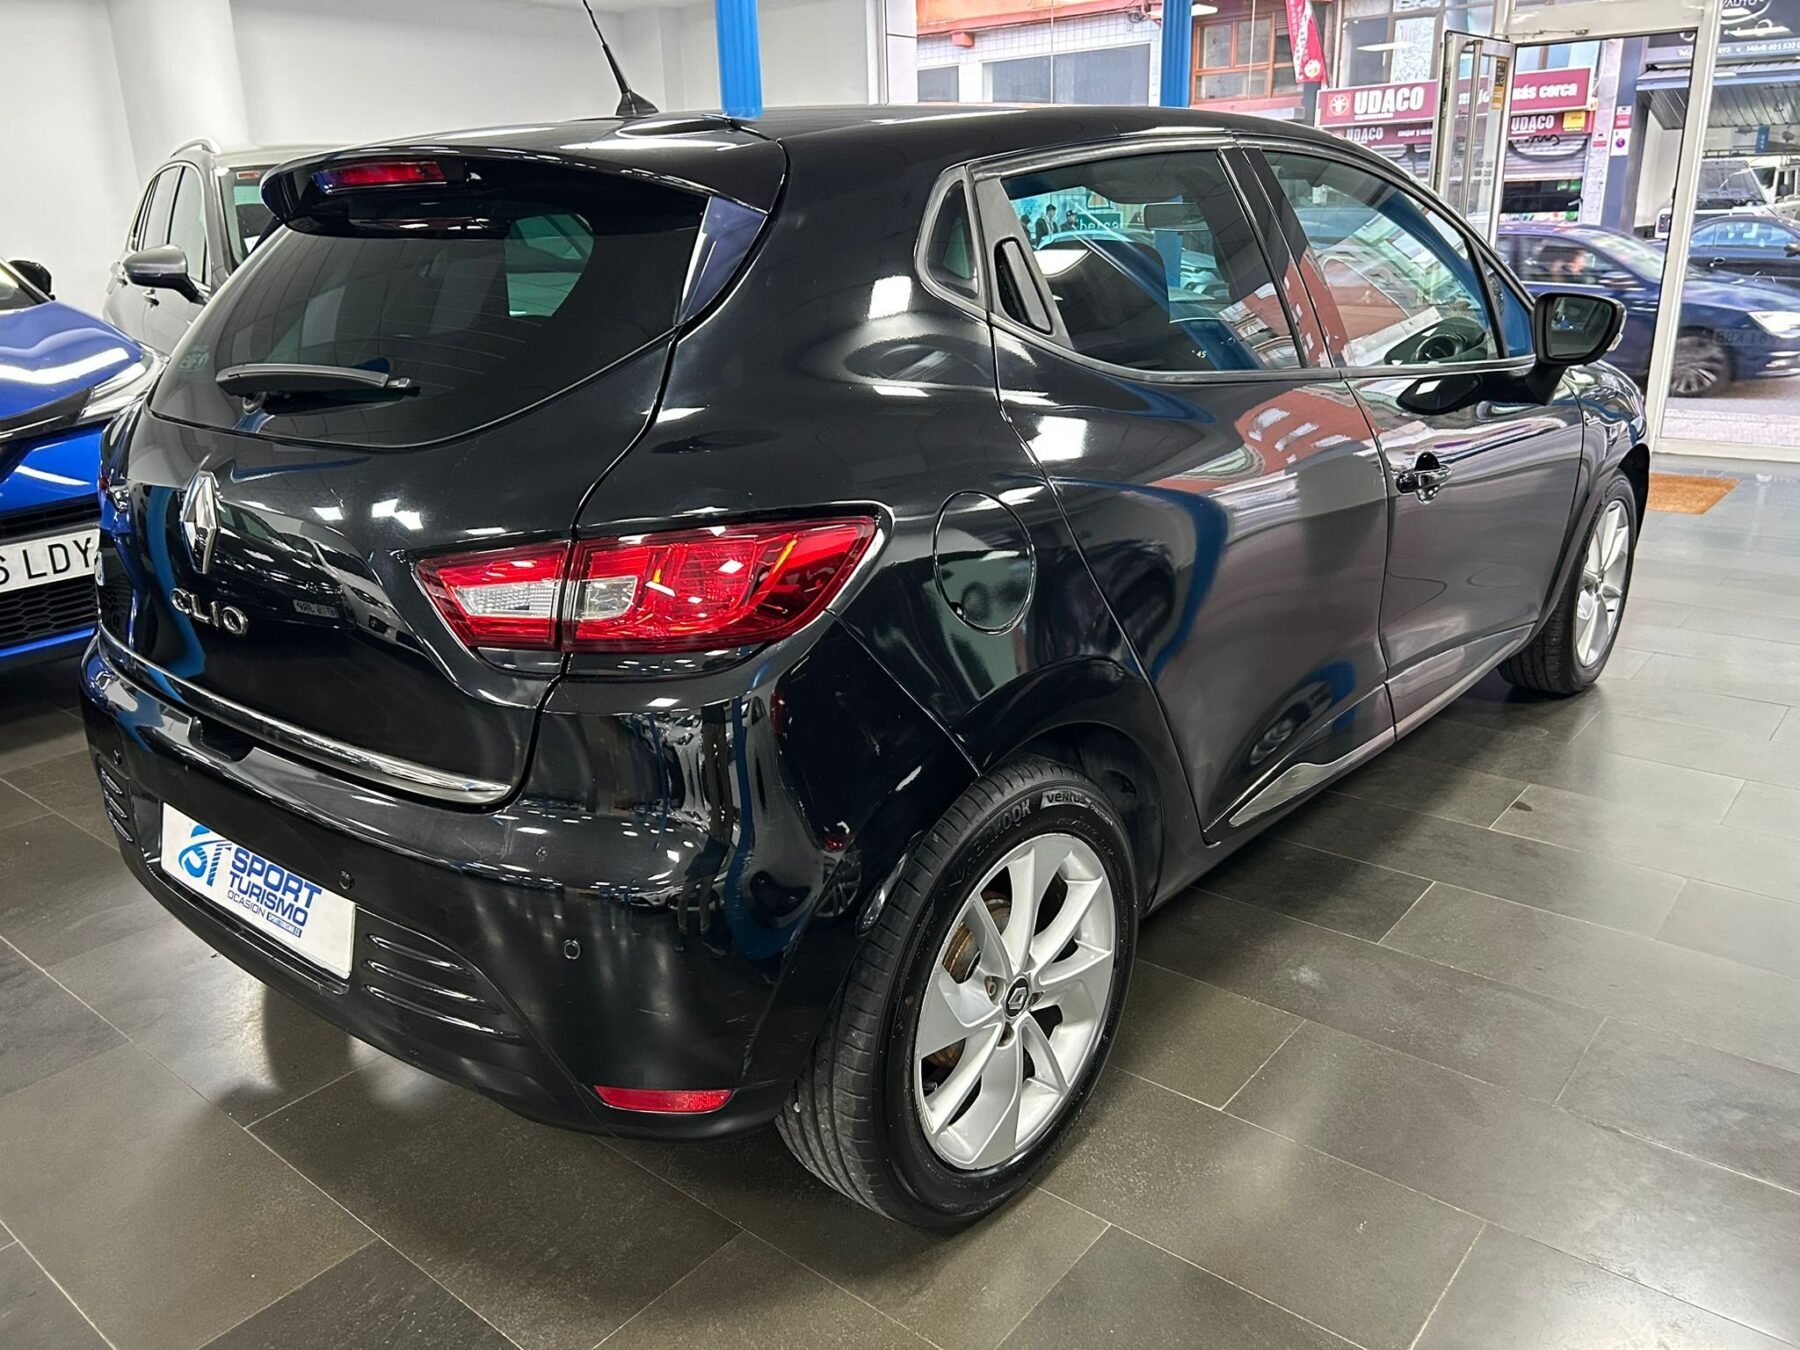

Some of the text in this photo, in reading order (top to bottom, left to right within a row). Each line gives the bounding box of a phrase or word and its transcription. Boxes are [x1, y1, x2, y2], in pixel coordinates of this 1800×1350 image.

[1354, 86, 1425, 115] UDACO
[1539, 82, 1578, 99] cerca
[1345, 127, 1384, 142] UDACO
[1511, 114, 1555, 131] UDACO
[22, 537, 92, 579] LDY
[170, 588, 248, 635] CLIO
[230, 847, 322, 909] SPORT
[226, 889, 267, 918] OCASION
[229, 871, 308, 927] TURISMO
